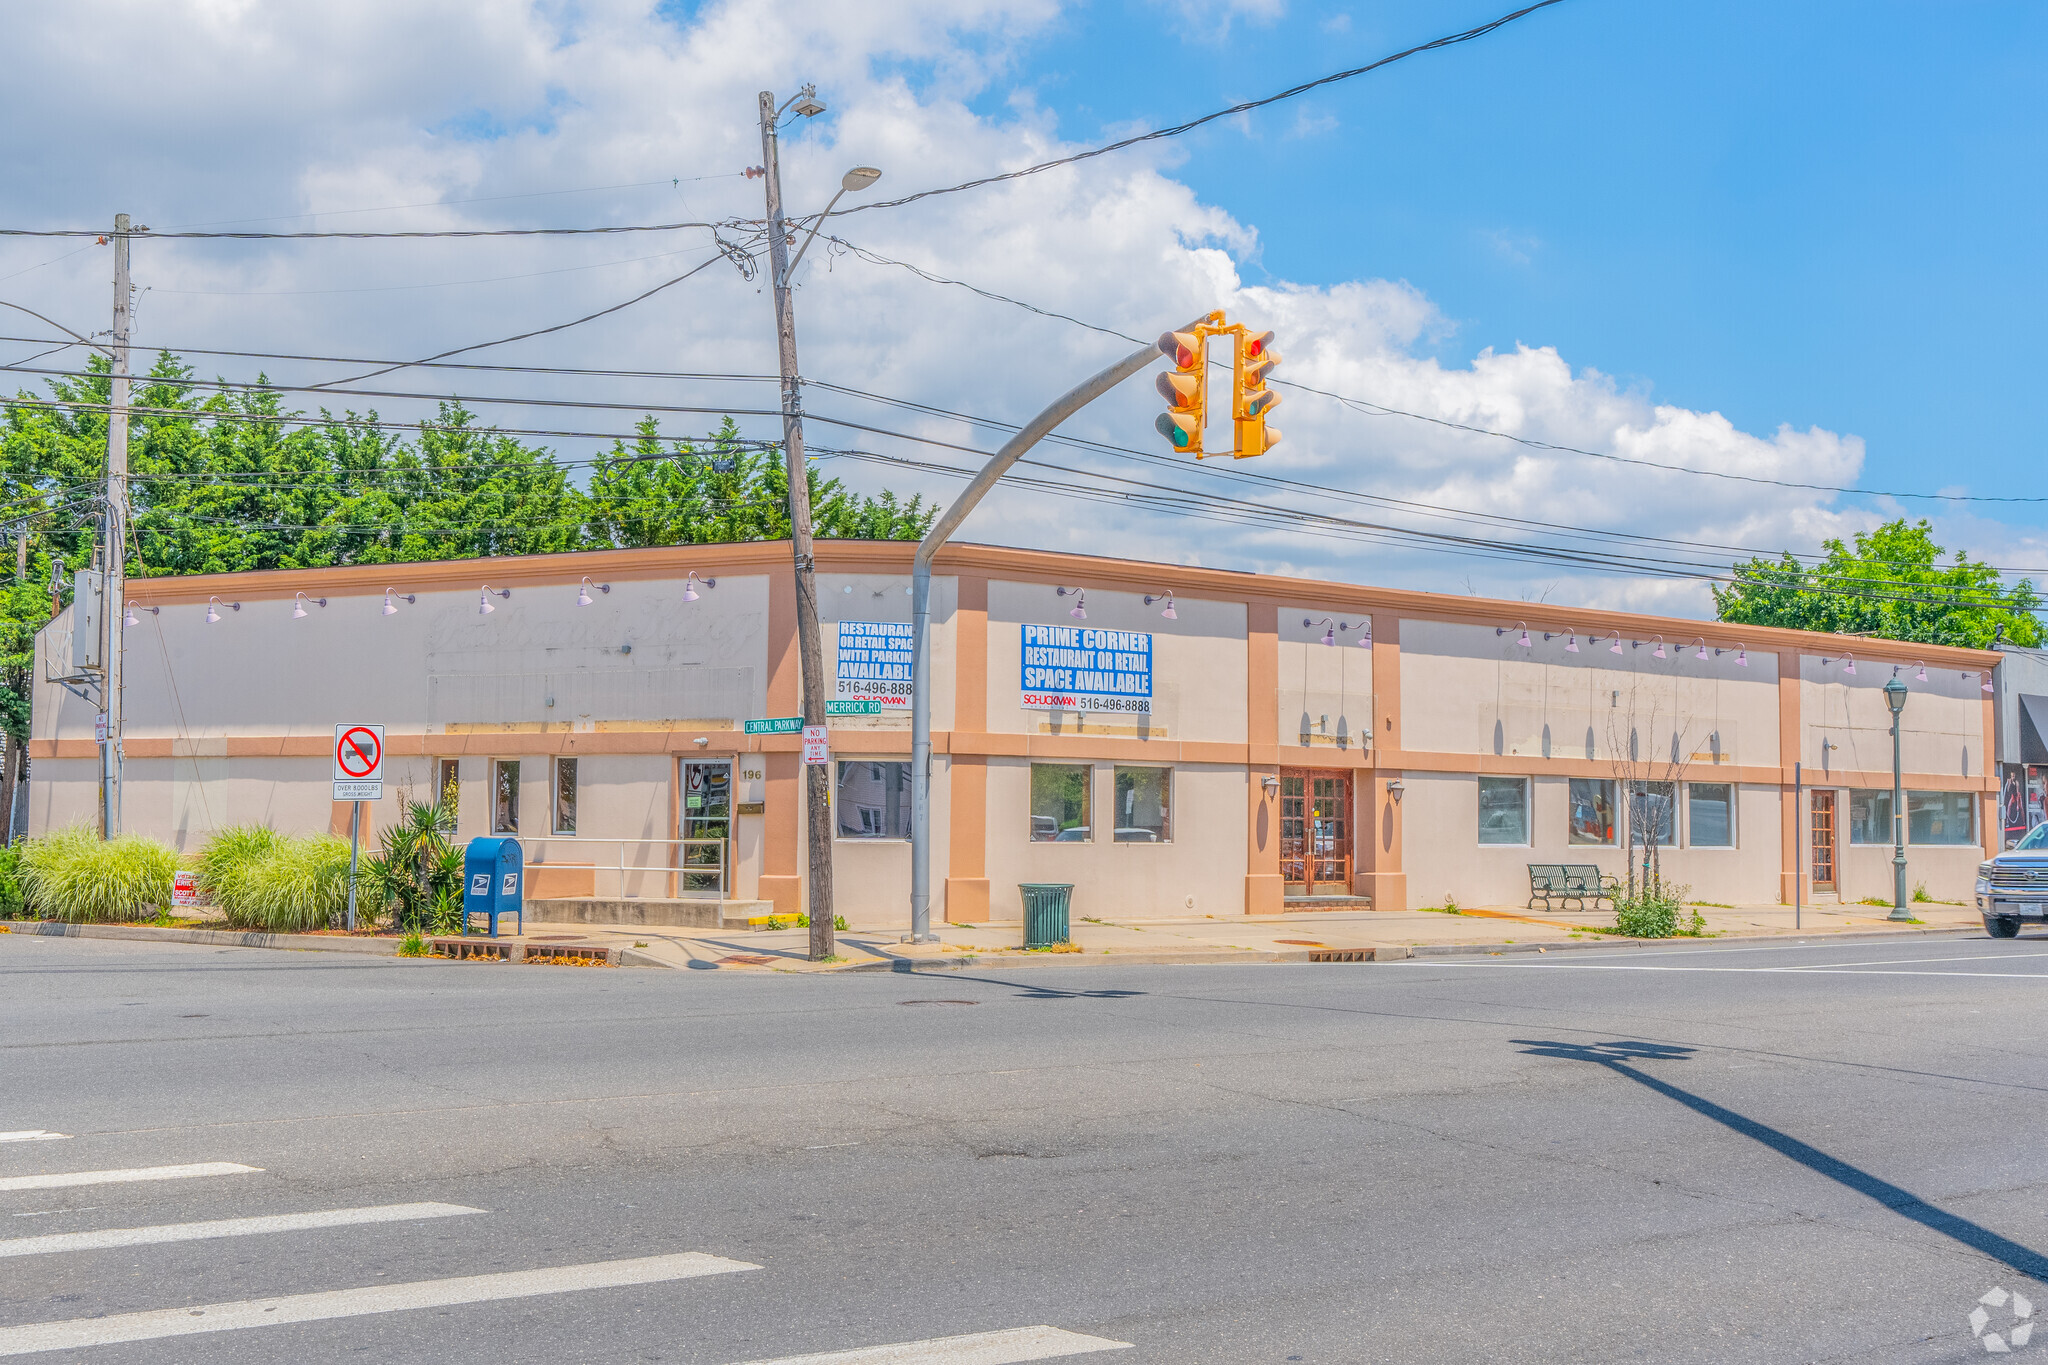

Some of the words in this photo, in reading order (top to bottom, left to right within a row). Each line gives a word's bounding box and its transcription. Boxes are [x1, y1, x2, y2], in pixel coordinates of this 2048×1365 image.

[841, 623, 912, 637] RESTAURAN
[840, 636, 854, 648] OR
[855, 636, 886, 649] RETAIL
[888, 638, 913, 650] SPAC
[1025, 626, 1079, 647] PRIME
[1083, 630, 1149, 652] CORNER
[840, 649, 869, 661] WITH
[872, 650, 912, 663] PARKIN
[1025, 646, 1095, 669] RESTAURANT
[1098, 651, 1112, 670] OR
[1115, 652, 1148, 672] RETAIL
[839, 662, 912, 680] AVAILABL
[1025, 667, 1072, 689] SPACE
[1075, 670, 1149, 694] AVAILABLE
[838, 681, 912, 695] 516-496-888
[826, 702, 865, 712] MERRICK
[869, 702, 880, 712] RD
[1024, 694, 1076, 706] SCHUCKMAN
[1080, 697, 1150, 712] 516-496-8888
[746, 721, 773, 732] CENTRAL
[775, 719, 802, 730] PARKWAY
[810, 729, 820, 737] NO
[743, 770, 761, 779] 196
